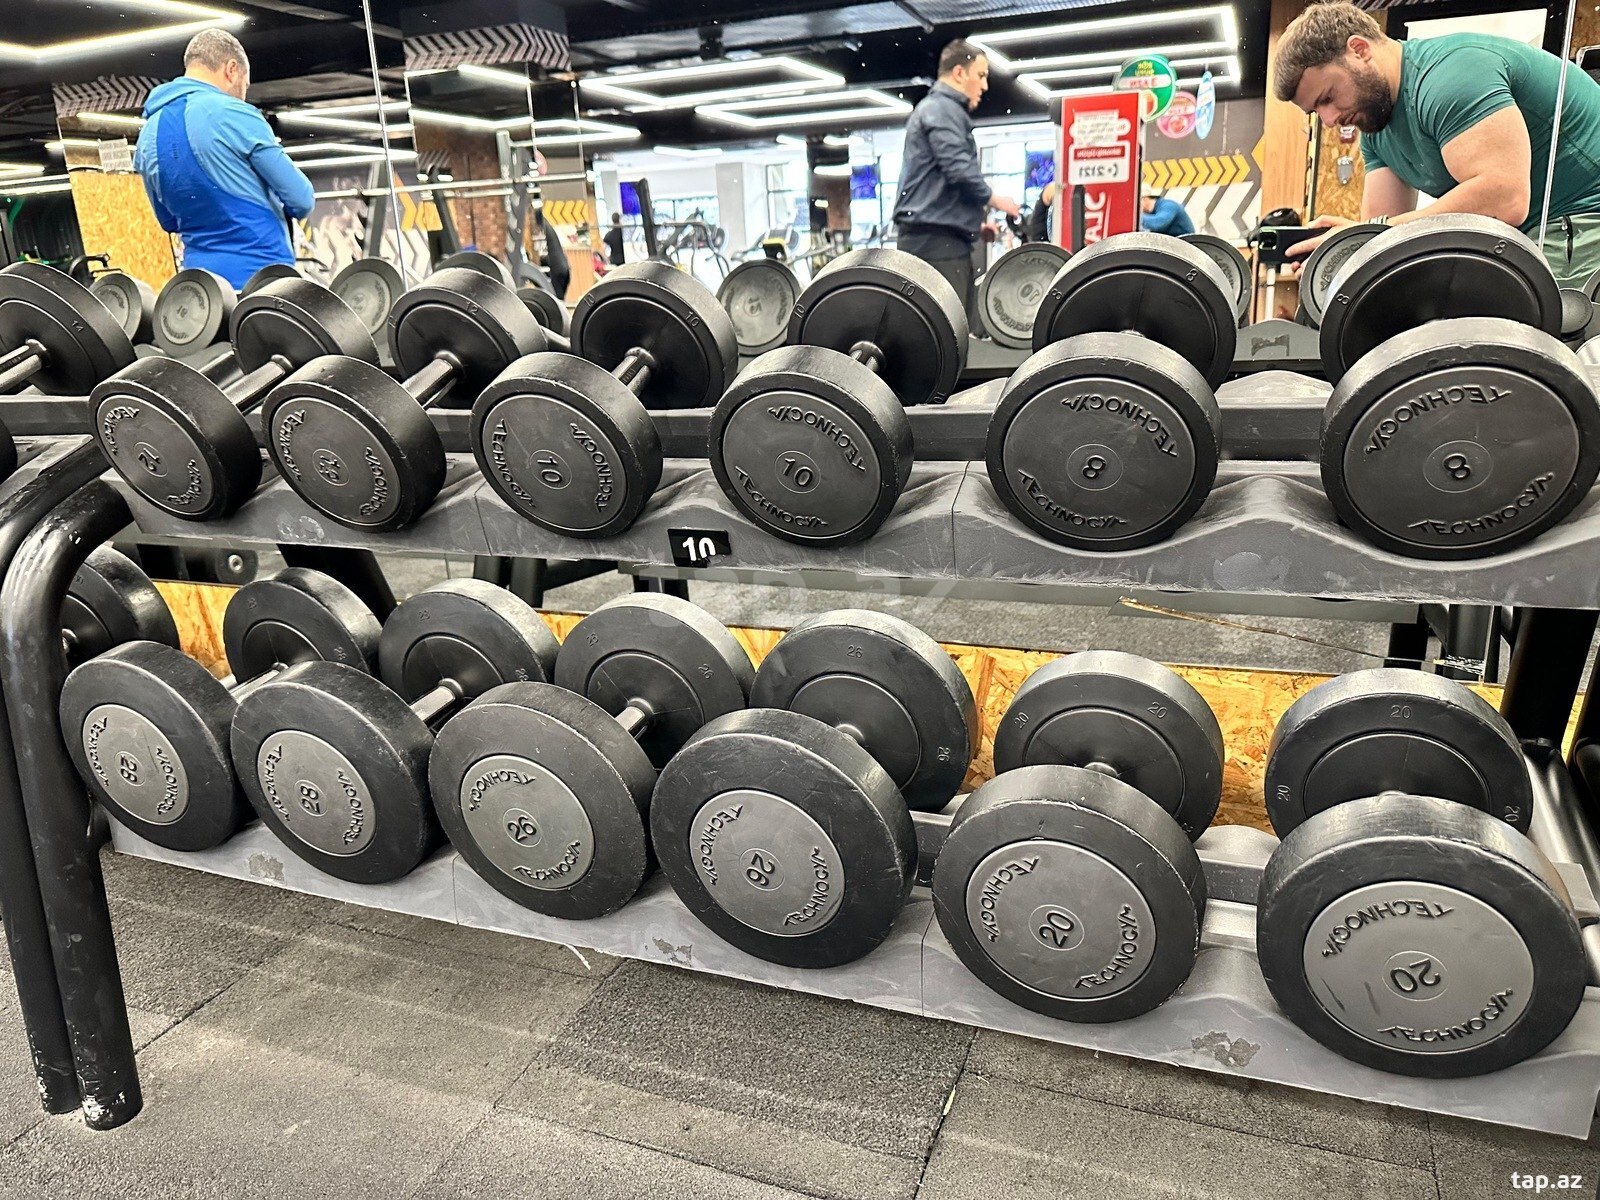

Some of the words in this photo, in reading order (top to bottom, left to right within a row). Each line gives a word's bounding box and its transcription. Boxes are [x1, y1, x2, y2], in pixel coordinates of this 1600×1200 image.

[1494, 240, 1506, 254] 8
[900, 280, 916, 297] 10
[1185, 268, 1198, 282] 8
[466, 301, 479, 316] 12
[1051, 288, 1063, 300] 8
[1336, 293, 1350, 305] 8
[685, 310, 700, 328] 10
[794, 303, 806, 319] 10
[1061, 393, 1179, 458] TECHNOGYM
[1364, 384, 1513, 455] TECHNOGYM
[767, 405, 866, 473] TECHNOGYM
[138, 447, 161, 472] 12
[492, 418, 536, 508] TECHNOGYM
[537, 456, 563, 485] 10
[569, 422, 613, 513] TECHNOGYM
[784, 457, 814, 488] 10
[1082, 454, 1107, 480] 8
[1443, 452, 1472, 481] 8
[735, 465, 829, 528] TECHNOGYM
[1018, 468, 1129, 528] TECHNOGYM
[1407, 472, 1555, 535] TECHNOGYM
[682, 536, 717, 562] 10
[847, 644, 864, 659] 26
[698, 663, 715, 680] 26
[1014, 712, 1030, 729] 20
[1147, 701, 1168, 720] 20
[1389, 704, 1412, 720] 20
[937, 746, 951, 762] 26
[120, 754, 138, 784] 28
[300, 785, 321, 815] 28
[469, 770, 536, 812] TECHNOGYM
[1277, 784, 1291, 802] 20
[1504, 805, 1521, 823] 20
[507, 815, 537, 843] 26
[700, 804, 744, 886] TECHNOGYM
[513, 840, 581, 881] TECHNOGYM
[746, 852, 776, 887] 26
[783, 846, 829, 927] TECHNOGYM
[980, 856, 1040, 943] TECHNOGYM
[1038, 910, 1075, 948] 20
[1321, 899, 1454, 957] TECHNOGYM
[1074, 904, 1138, 989] TECHNOGYM
[1389, 959, 1441, 993] 20
[1377, 988, 1514, 1042] TECHNOGYM
